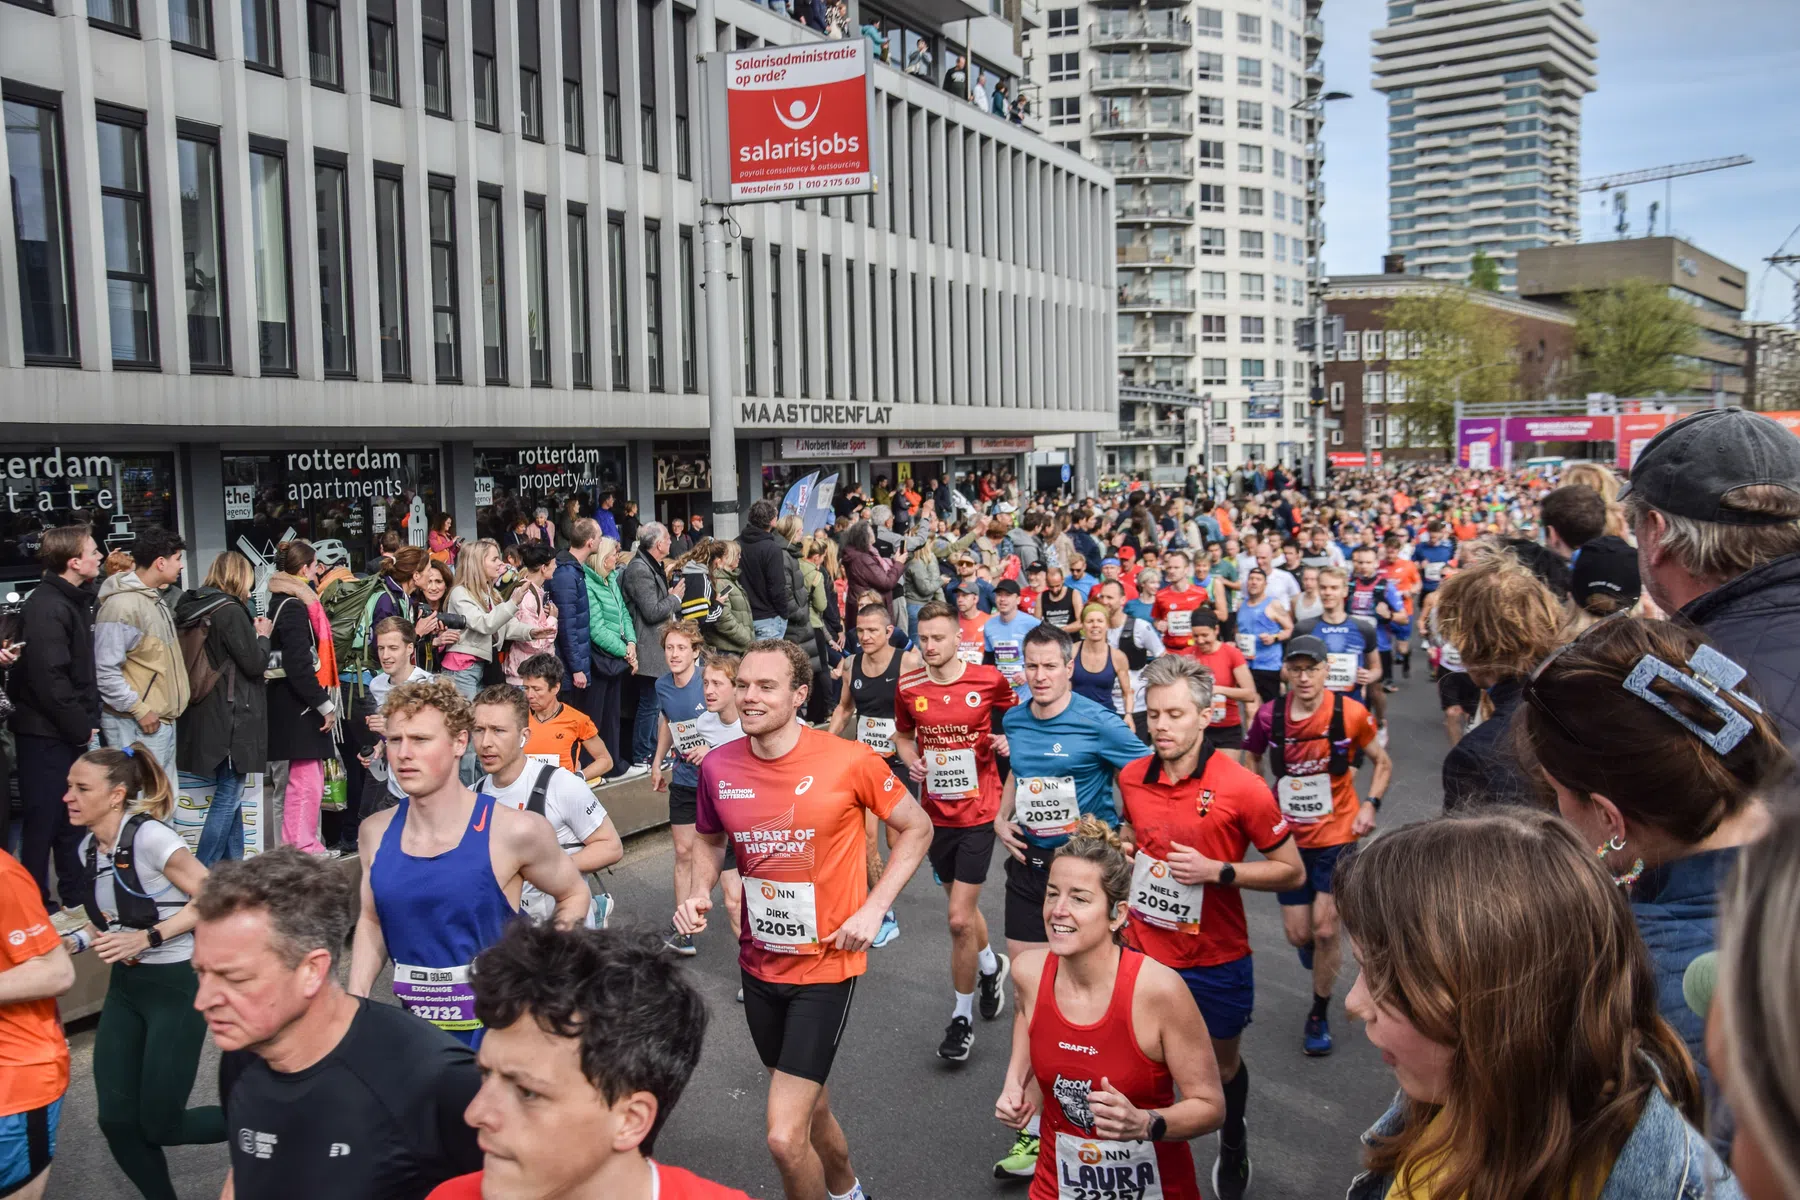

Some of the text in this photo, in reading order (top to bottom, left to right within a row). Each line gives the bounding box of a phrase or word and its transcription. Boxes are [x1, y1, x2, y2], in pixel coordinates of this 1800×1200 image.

[735, 46, 857, 71] Salarisadministratie
[735, 69, 787, 87] op orde?
[739, 132, 860, 162] salarisjobs
[739, 167, 765, 179] payroll
[766, 164, 809, 177] consultancy
[817, 160, 861, 172] outsourcing
[740, 185, 781, 196] Westplein
[783, 182, 794, 190] 5D
[806, 180, 821, 189] 010
[830, 178, 843, 186] 175
[845, 177, 860, 186] 630
[741, 402, 892, 424] MAASTORENFLAT
[804, 439, 866, 453] Norbert Maier Sport
[288, 445, 401, 471] rotterdam
[518, 443, 599, 465] rotterdam
[474, 479, 491, 492] the
[519, 470, 580, 497] property
[226, 487, 250, 504] the
[288, 476, 402, 508] apartments
[227, 508, 251, 519] agency
[920, 724, 969, 734] Stichting
[680, 739, 706, 750] 22107
[934, 769, 965, 777] JEROEN
[934, 778, 970, 788] 22135
[1044, 782, 1059, 790] NN
[1030, 800, 1060, 808] EELCO
[1288, 802, 1323, 812] 16150
[1025, 809, 1070, 822] 20327
[734, 829, 815, 843] BE PART OF
[745, 842, 806, 854] HISTORY
[777, 889, 795, 899] NN
[1150, 883, 1179, 899] NIELS
[1137, 891, 1191, 917] 20947
[766, 907, 789, 919] DIRK
[756, 918, 806, 937] 22051
[411, 985, 453, 993] EXCHANGE
[452, 994, 475, 1002] Union
[410, 1005, 462, 1020] 32732
[1058, 1041, 1089, 1053] CRAFT
[1053, 1088, 1092, 1098] RUNNIN
[1105, 1149, 1131, 1160] NN
[1061, 1159, 1154, 1190] LAURA
[1073, 1186, 1146, 1200] 22257
